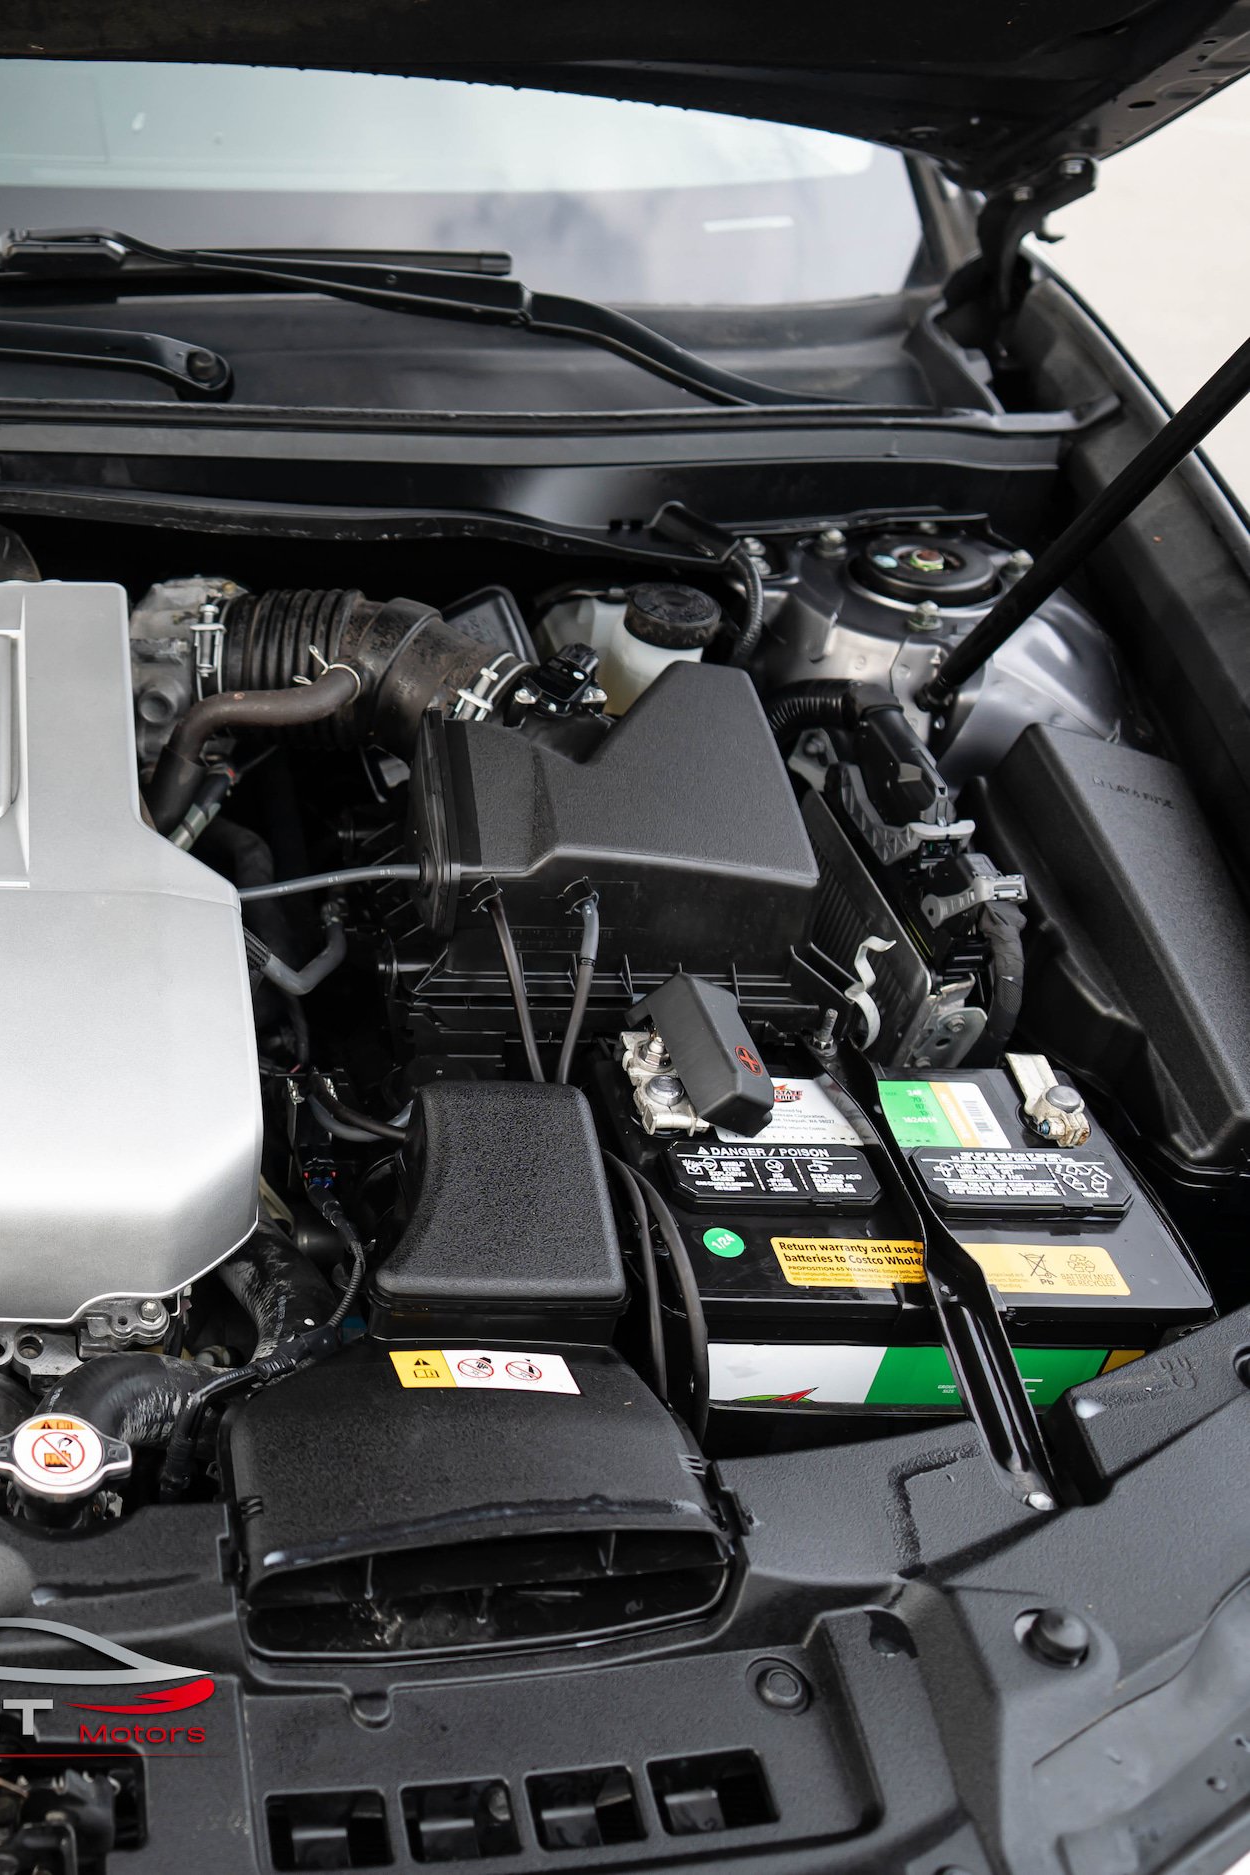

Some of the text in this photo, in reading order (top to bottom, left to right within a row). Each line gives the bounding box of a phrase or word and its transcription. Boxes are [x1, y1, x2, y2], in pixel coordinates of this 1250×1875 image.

[709, 1147, 766, 1157] DANGER
[780, 1148, 830, 1158] POISON
[711, 1233, 735, 1250] 1/24
[779, 1242, 817, 1251] Return
[819, 1243, 869, 1255] warranty
[871, 1245, 892, 1253] and
[784, 1253, 833, 1263] batteries
[834, 1255, 847, 1263] to
[848, 1255, 884, 1265] Costco
[1040, 1278, 1054, 1286] Pb
[1060, 1273, 1092, 1281] BATTERY
